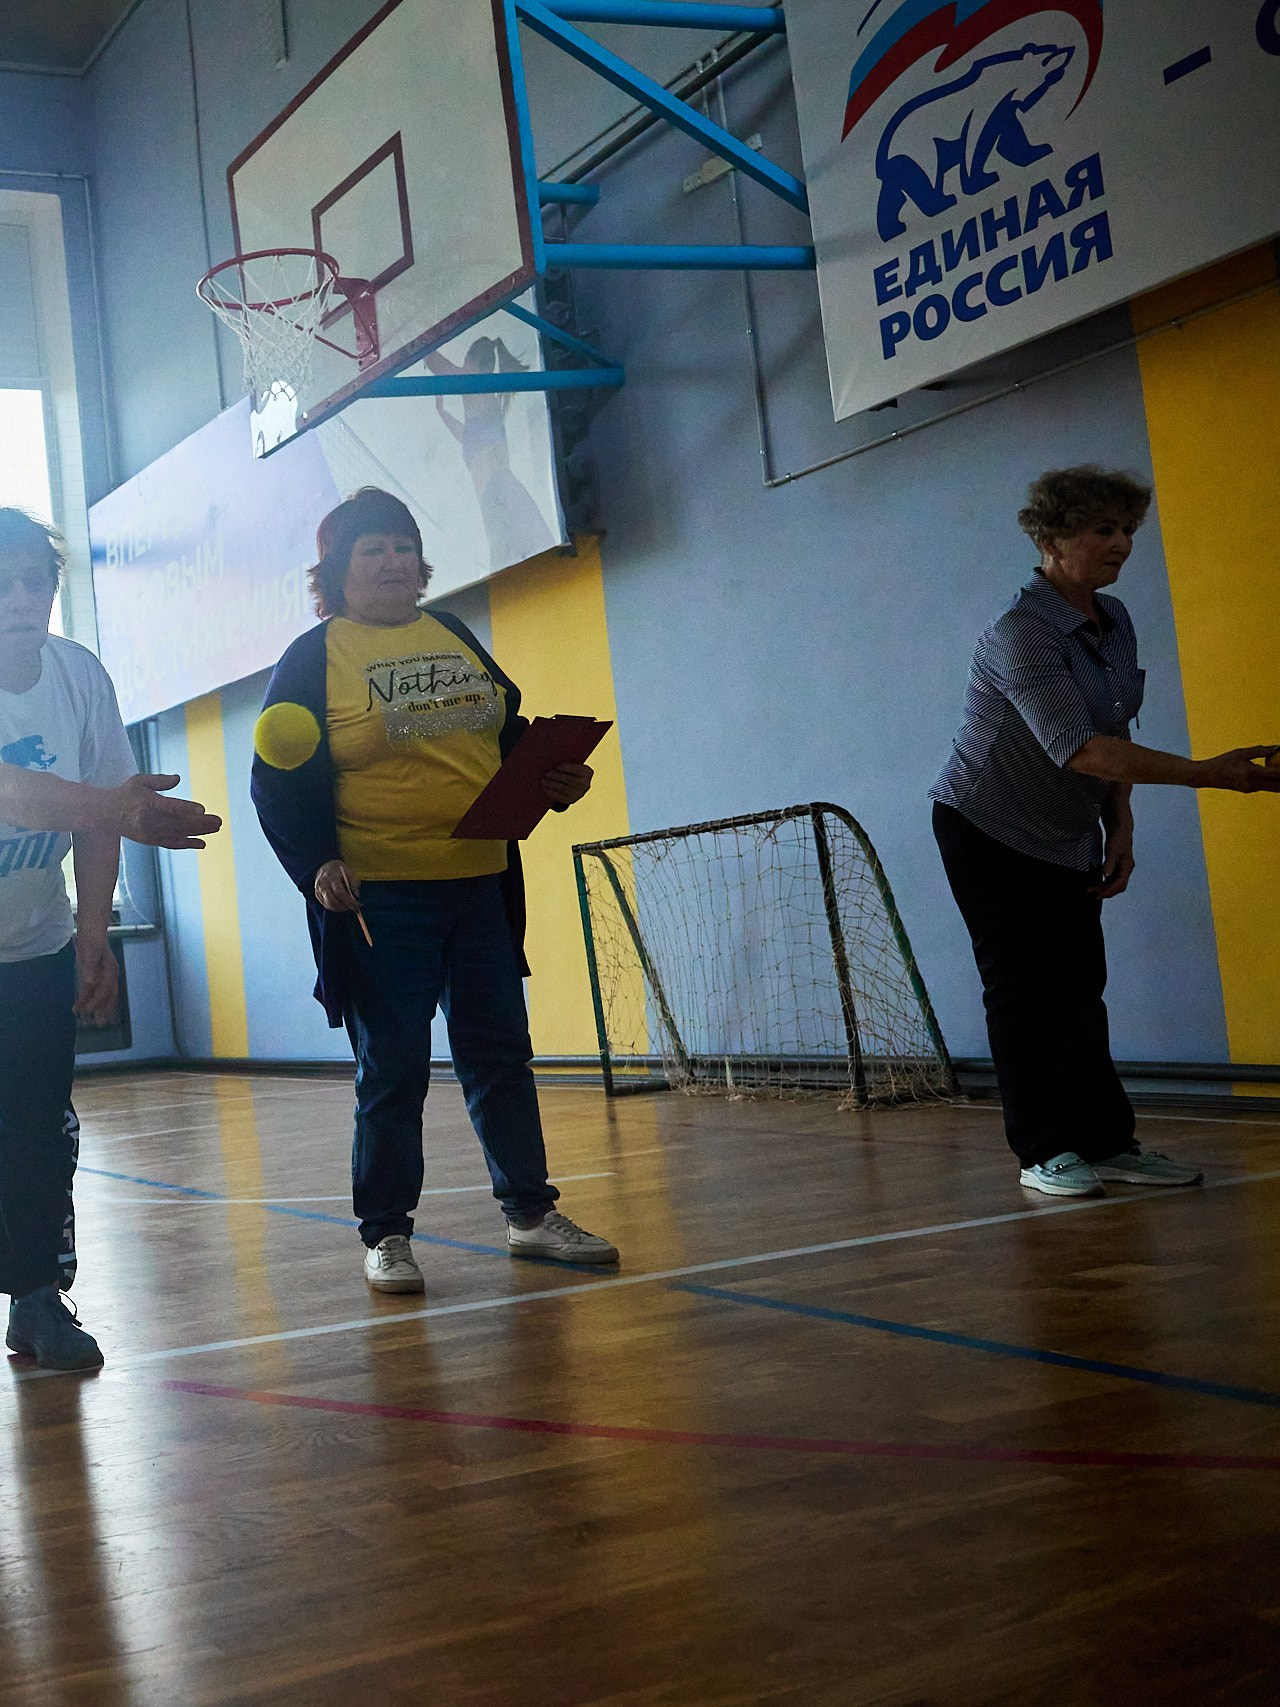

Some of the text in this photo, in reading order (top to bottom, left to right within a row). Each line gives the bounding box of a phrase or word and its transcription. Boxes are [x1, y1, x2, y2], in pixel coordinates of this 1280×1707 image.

[873, 152, 1105, 306] ЕДИНАЯ
[879, 210, 1114, 360] РОССИЯ
[120, 562, 311, 703] ДОСТИЖЕНИЯ
[366, 660, 397, 673] WHAT
[398, 656, 421, 667] YOU
[366, 663, 498, 712] Nothing
[408, 693, 485, 713] don't me up.
